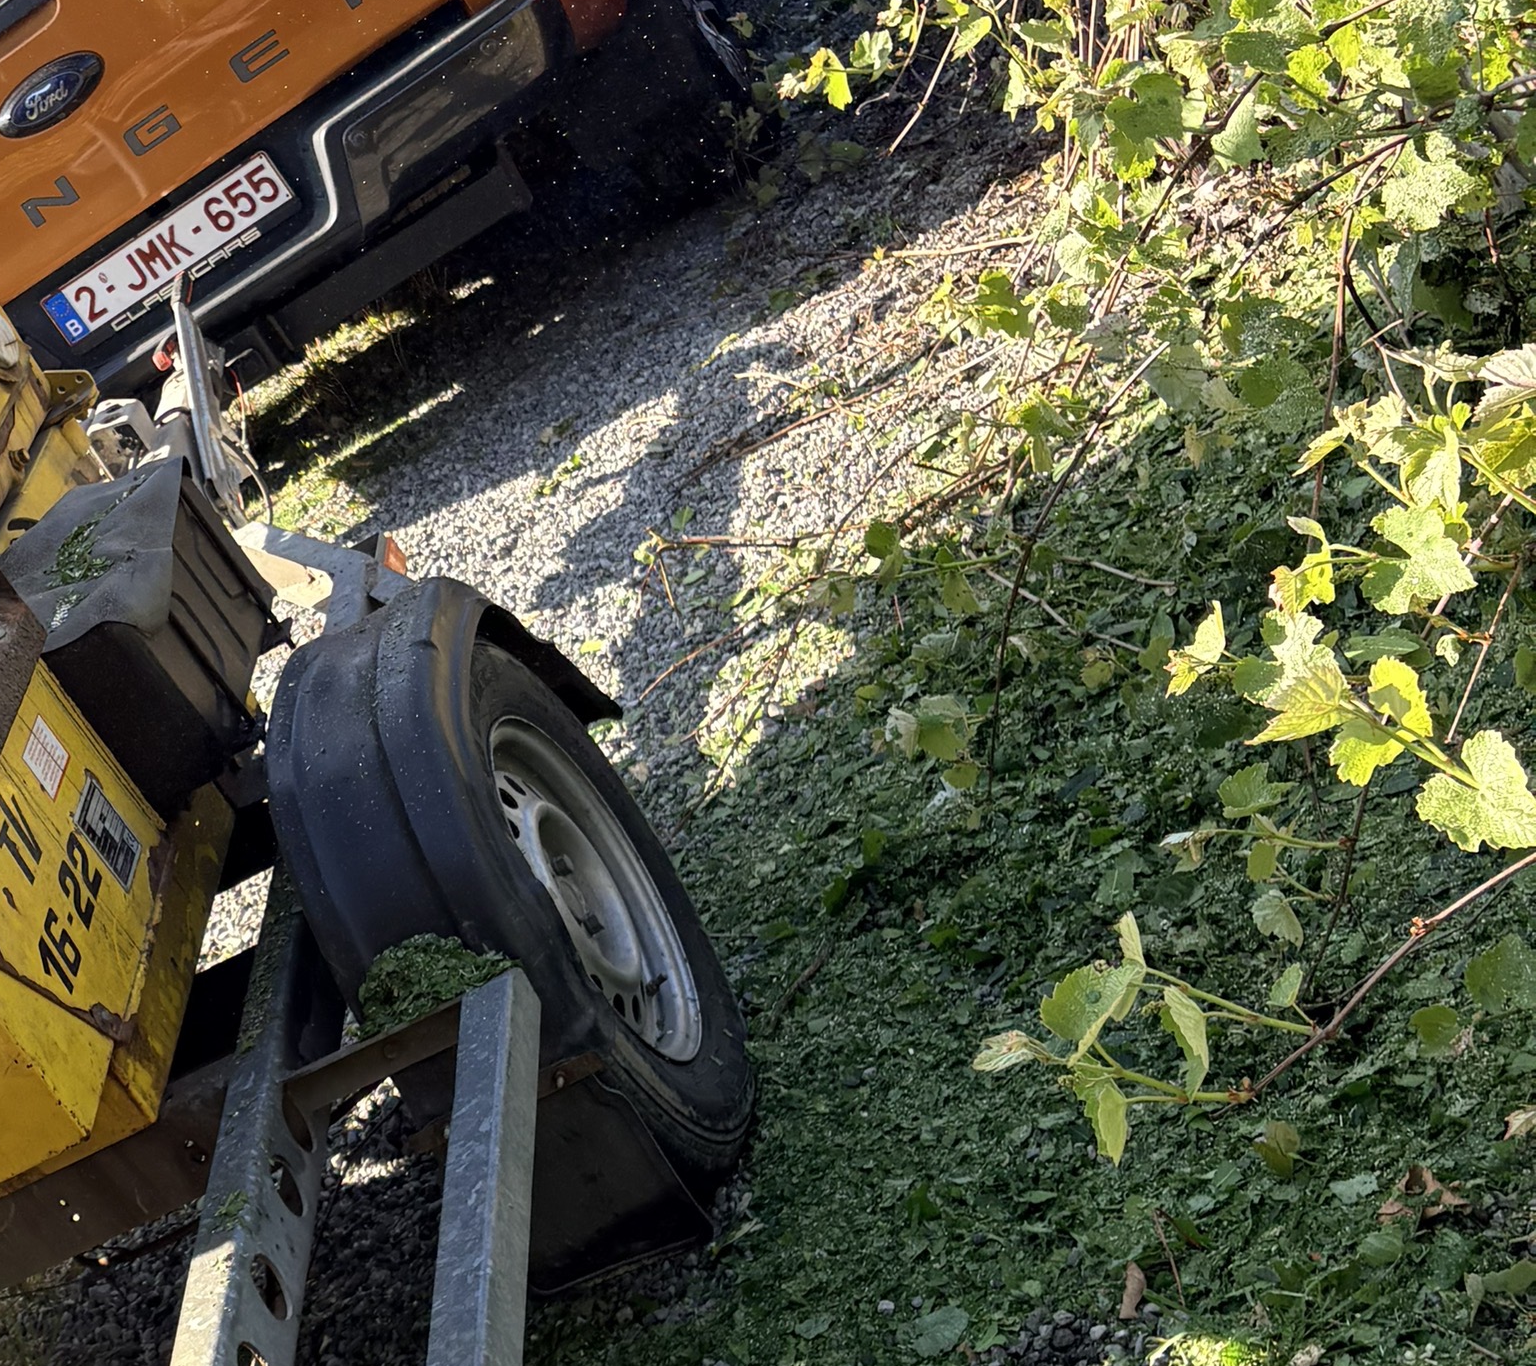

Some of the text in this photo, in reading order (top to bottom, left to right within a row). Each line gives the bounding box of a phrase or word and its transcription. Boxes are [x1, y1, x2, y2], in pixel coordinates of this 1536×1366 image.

[23, 80, 69, 121] Ford
[65, 164, 279, 338] B 2-JMK-655
